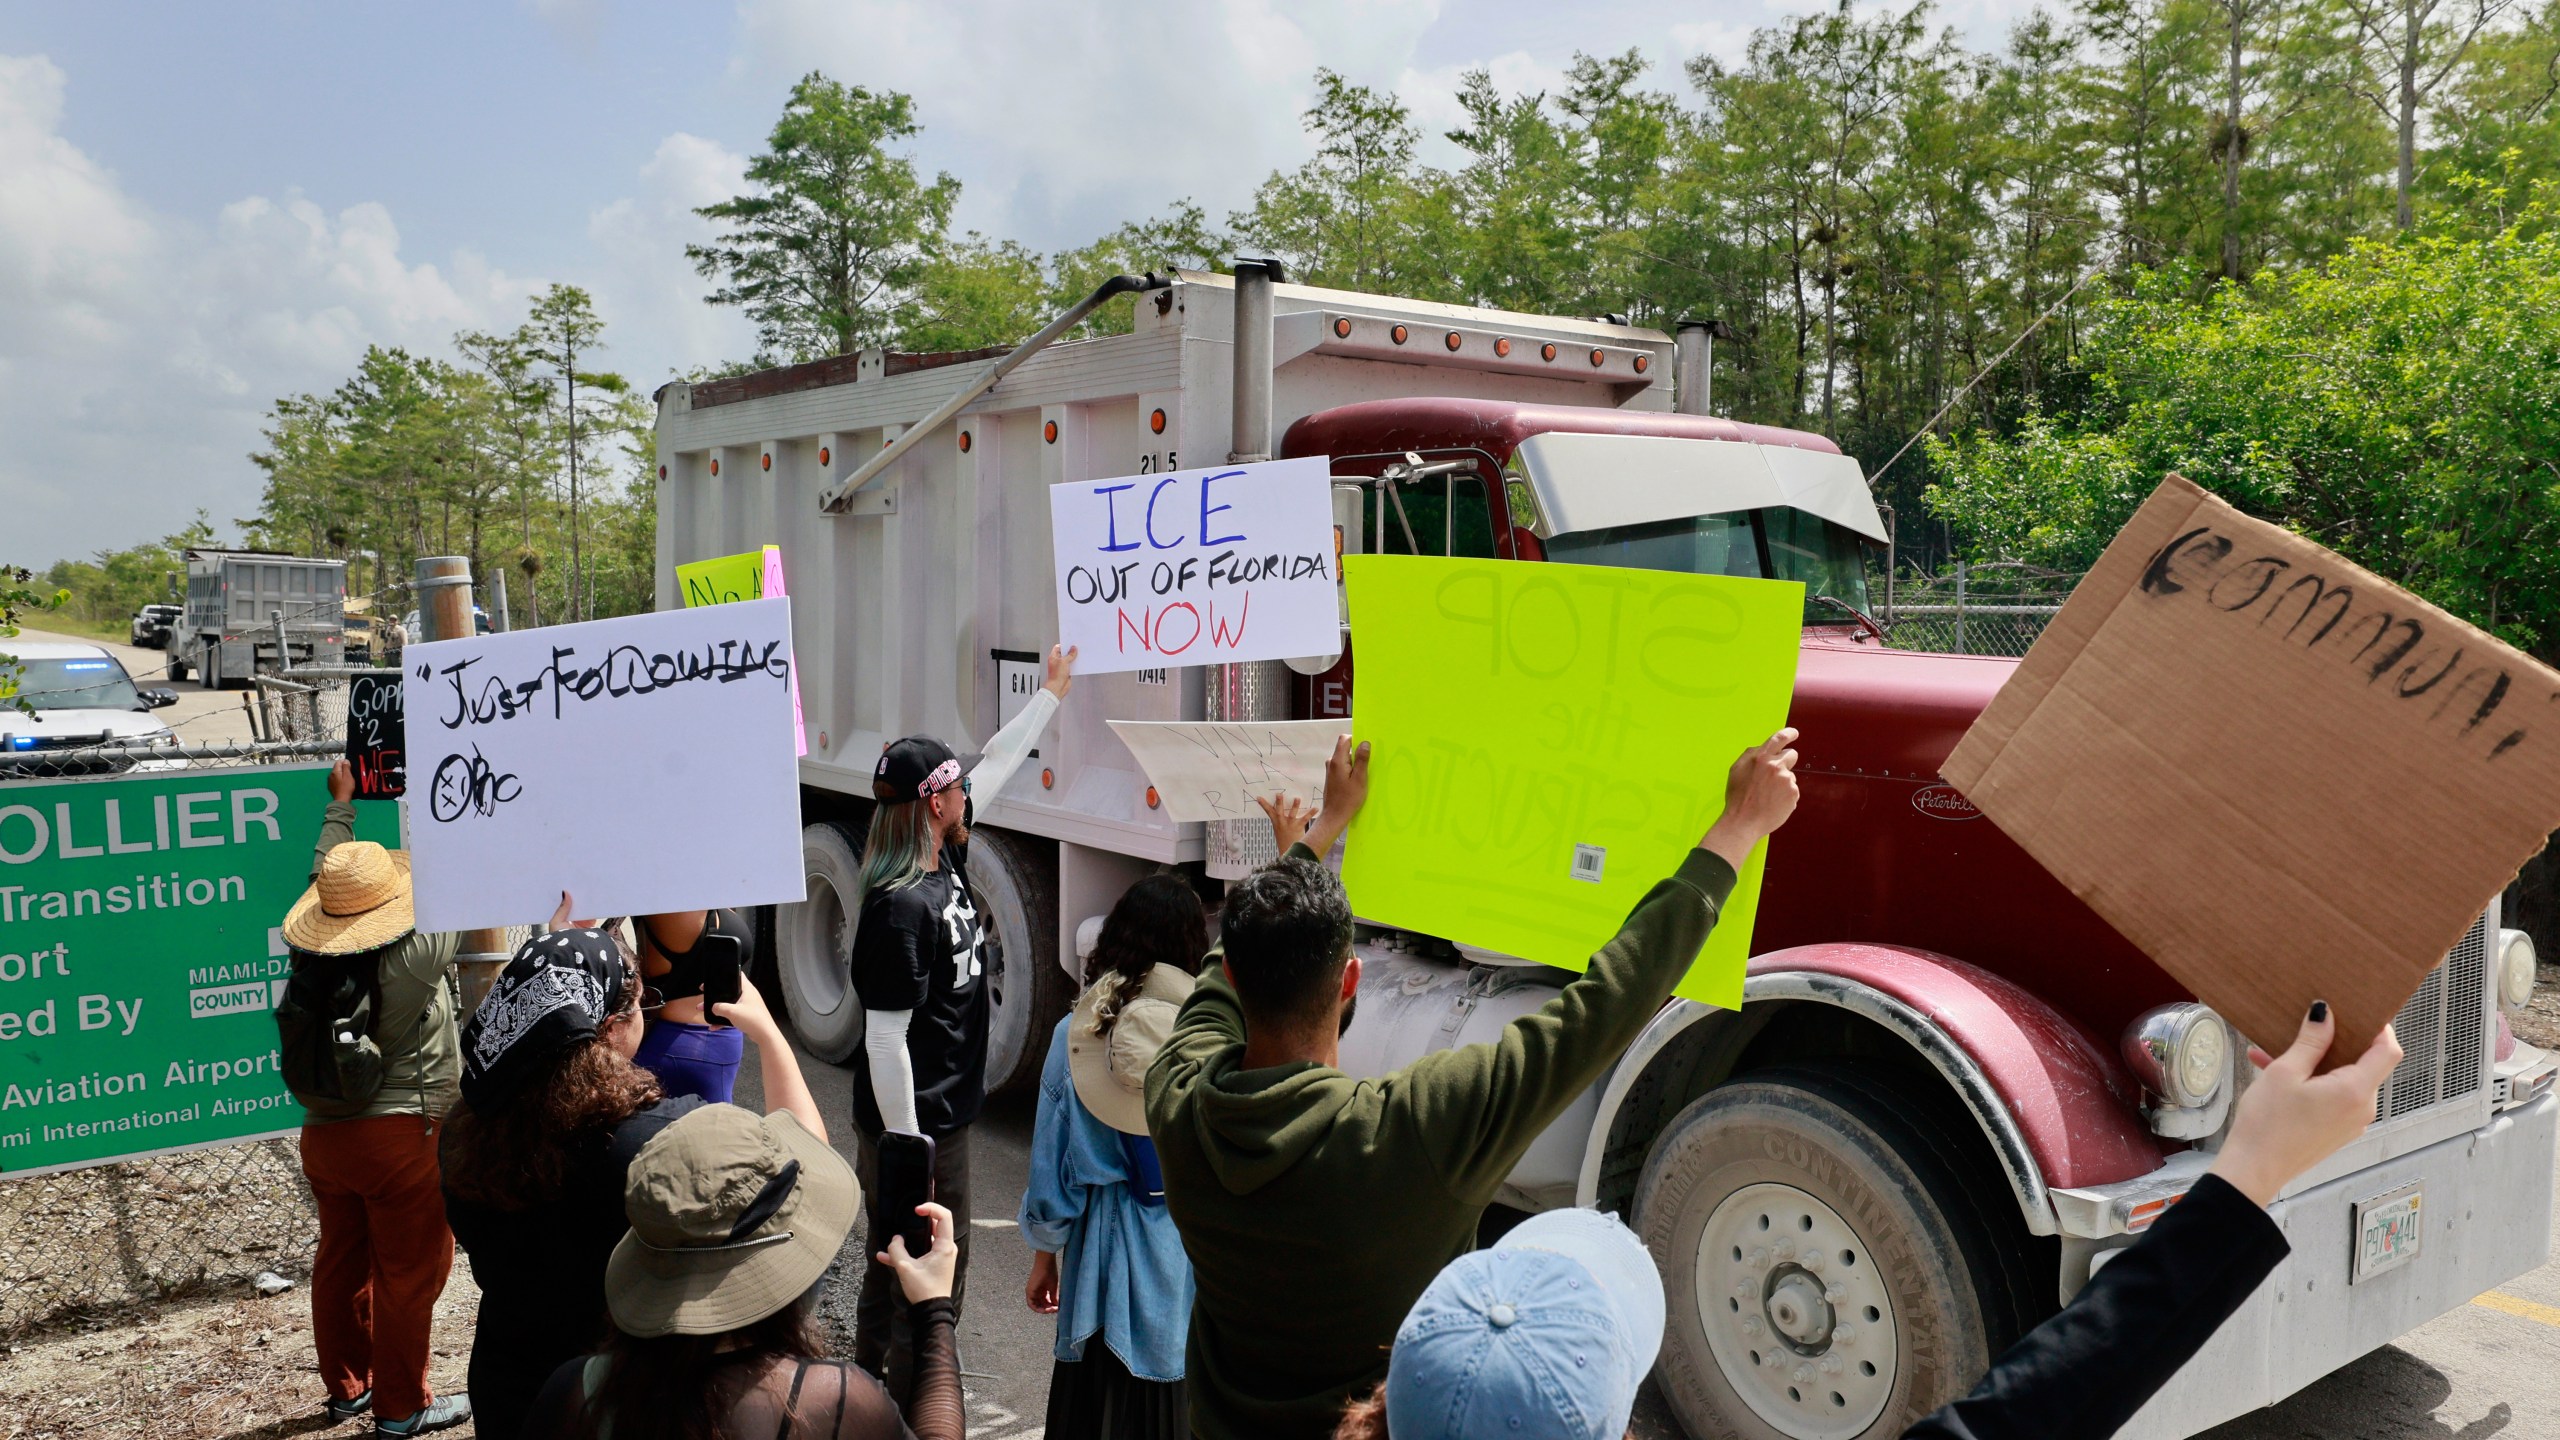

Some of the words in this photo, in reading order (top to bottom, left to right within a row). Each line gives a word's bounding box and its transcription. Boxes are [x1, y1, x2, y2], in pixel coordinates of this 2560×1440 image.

[1141, 454, 1157, 475] 21
[1168, 451, 1177, 472] 5
[1093, 470, 1248, 552] ICE
[1067, 562, 1140, 605] OUT
[1151, 557, 1199, 596] OF
[1207, 549, 1329, 592] FLORIDA
[1117, 590, 1249, 656] NOW
[1233, 760, 1295, 785] LA
[0, 787, 281, 864] OLLIER
[0, 872, 246, 922] Transition
[0, 942, 70, 982] ort
[78, 994, 143, 1036] By
[193, 989, 265, 1011] COUNTY
[1, 1072, 147, 1111] Aviation
[163, 1049, 281, 1086] Airport
[2, 1128, 31, 1148] mi
[43, 1103, 200, 1142] International
[211, 1089, 292, 1117] Airport
